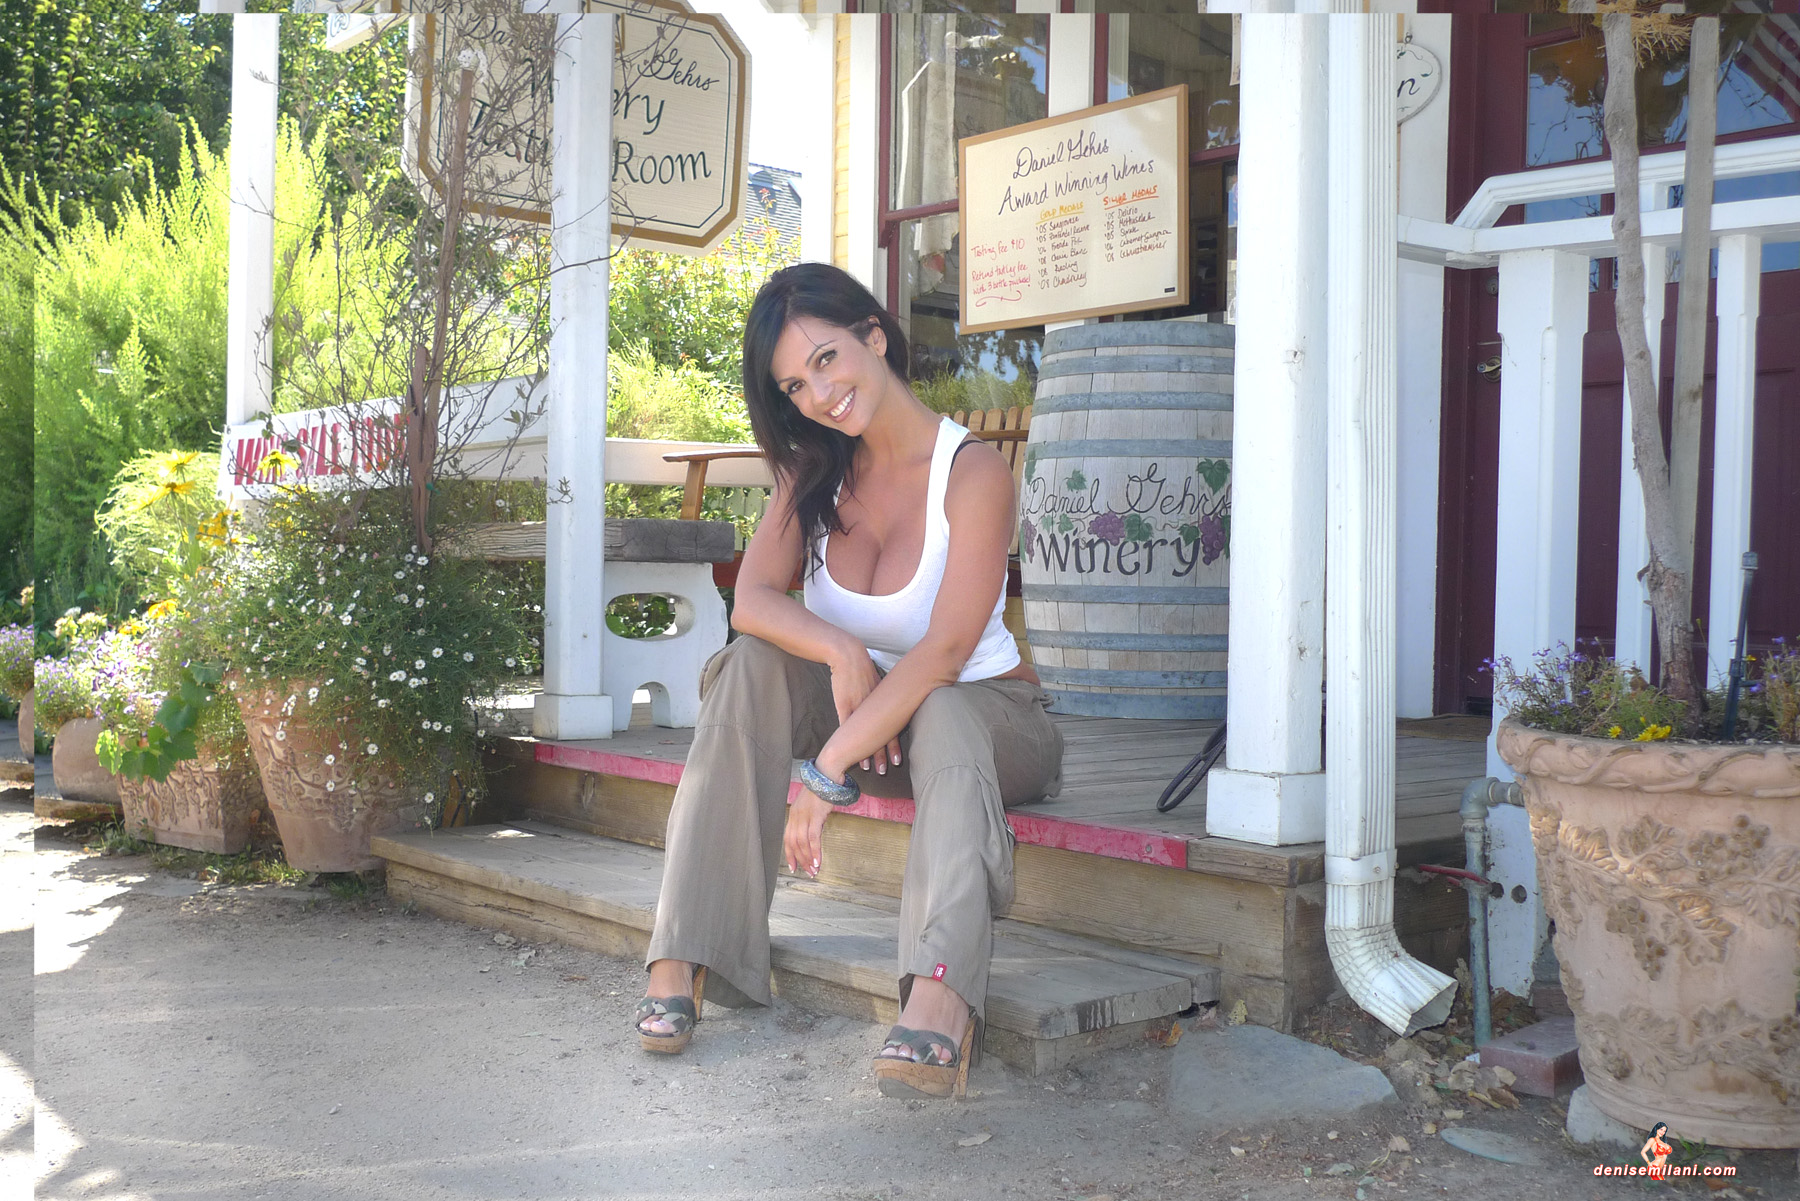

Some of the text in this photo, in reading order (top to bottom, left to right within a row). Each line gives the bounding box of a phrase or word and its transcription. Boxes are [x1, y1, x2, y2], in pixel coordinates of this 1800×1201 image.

[637, 48, 720, 91] Gehrs
[612, 141, 712, 184] Room
[1013, 141, 1064, 179] Daniel
[998, 153, 1154, 216] Award Winning Wines
[971, 243, 997, 261] Tasting
[1011, 238, 1026, 251] $10
[1026, 476, 1100, 515] Daniel
[1036, 527, 1201, 577] Winery
